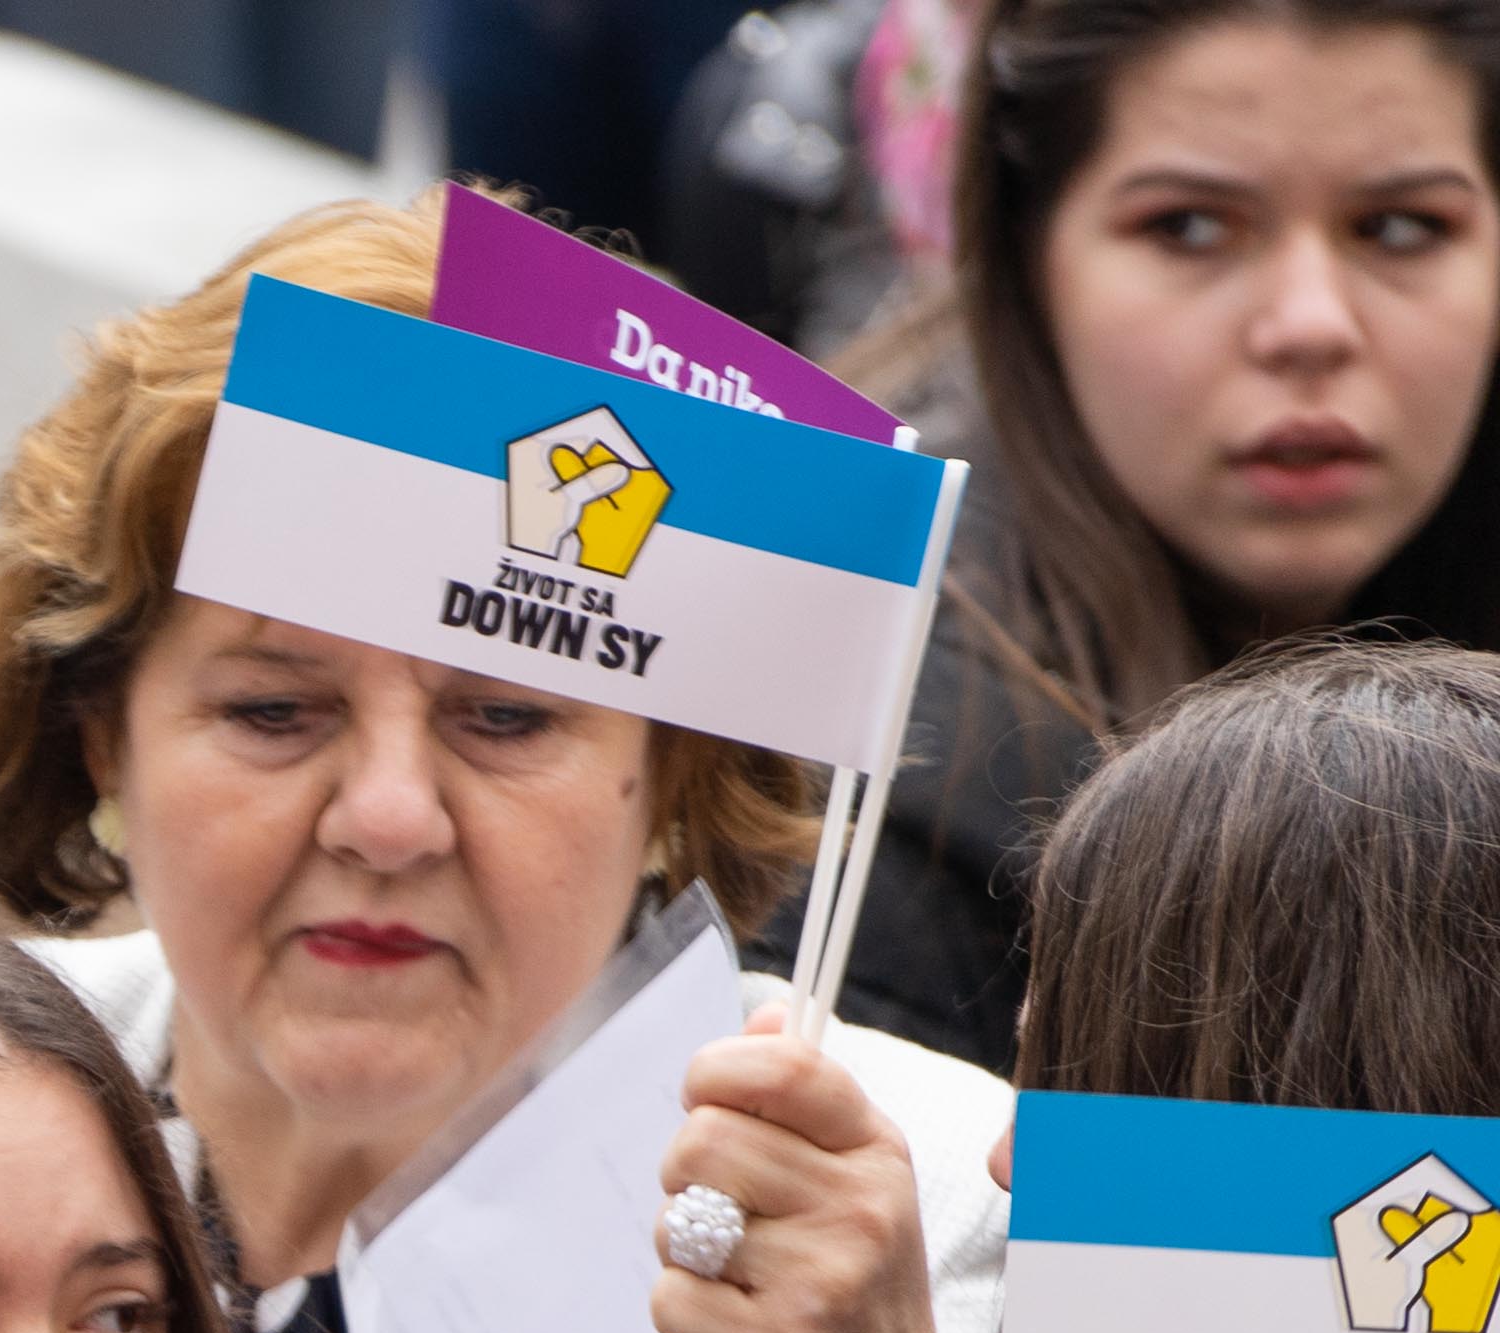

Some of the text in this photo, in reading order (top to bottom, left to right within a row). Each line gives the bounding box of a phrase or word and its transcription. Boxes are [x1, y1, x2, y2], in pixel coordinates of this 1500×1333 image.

[610, 308, 684, 390] Da
[494, 556, 615, 618] ŽIVOT SA
[439, 579, 664, 678] DOWN SY
